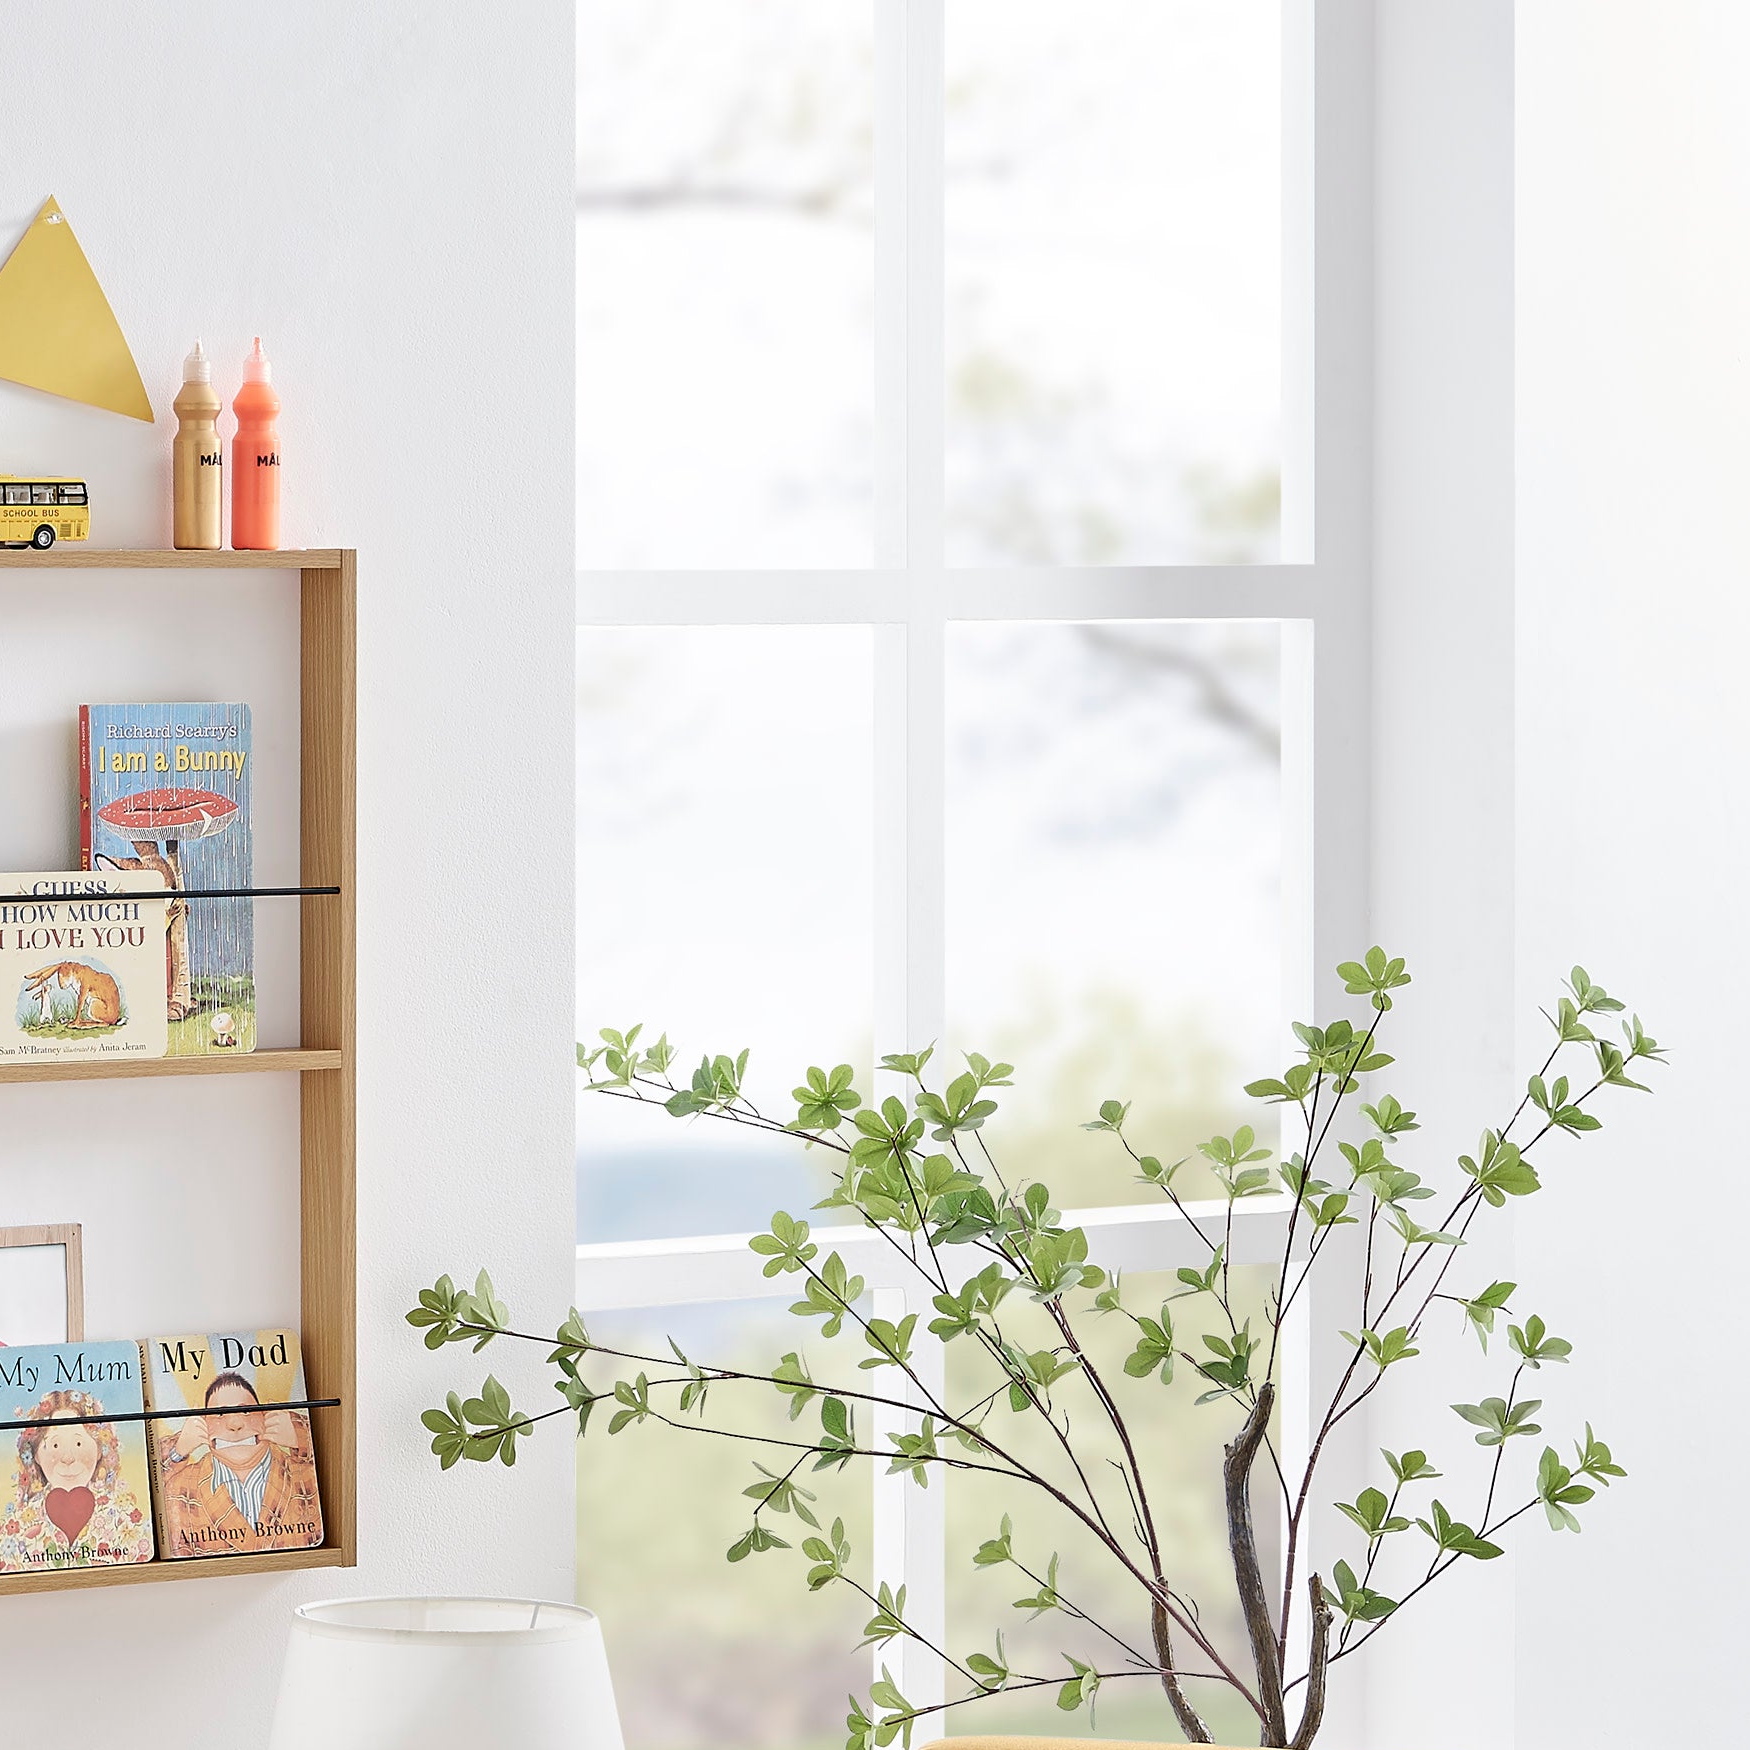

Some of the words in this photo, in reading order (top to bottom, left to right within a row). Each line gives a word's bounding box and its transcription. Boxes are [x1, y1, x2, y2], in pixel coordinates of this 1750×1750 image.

[3, 509, 38, 517] SCHOOL
[42, 509, 59, 517] BUS
[106, 724, 172, 739] Richard
[175, 722, 238, 741] Scarry's
[99, 746, 105, 773] I
[111, 751, 148, 773] am
[154, 751, 170, 773] a
[175, 745, 246, 781] Bunny
[1, 904, 58, 924] HOW
[68, 903, 140, 923] MUCH
[15, 927, 84, 951] LOVE
[91, 926, 145, 948] YOU
[98, 1043, 120, 1052] Anita
[122, 1042, 147, 1051] Jeram
[53, 1352, 132, 1384] Mum
[159, 1341, 206, 1380] My
[219, 1334, 290, 1369] Dad
[180, 1526, 247, 1544] Anthony
[254, 1521, 316, 1538] Browne
[22, 1548, 78, 1563] Anthony
[80, 1546, 129, 1559] Browne
